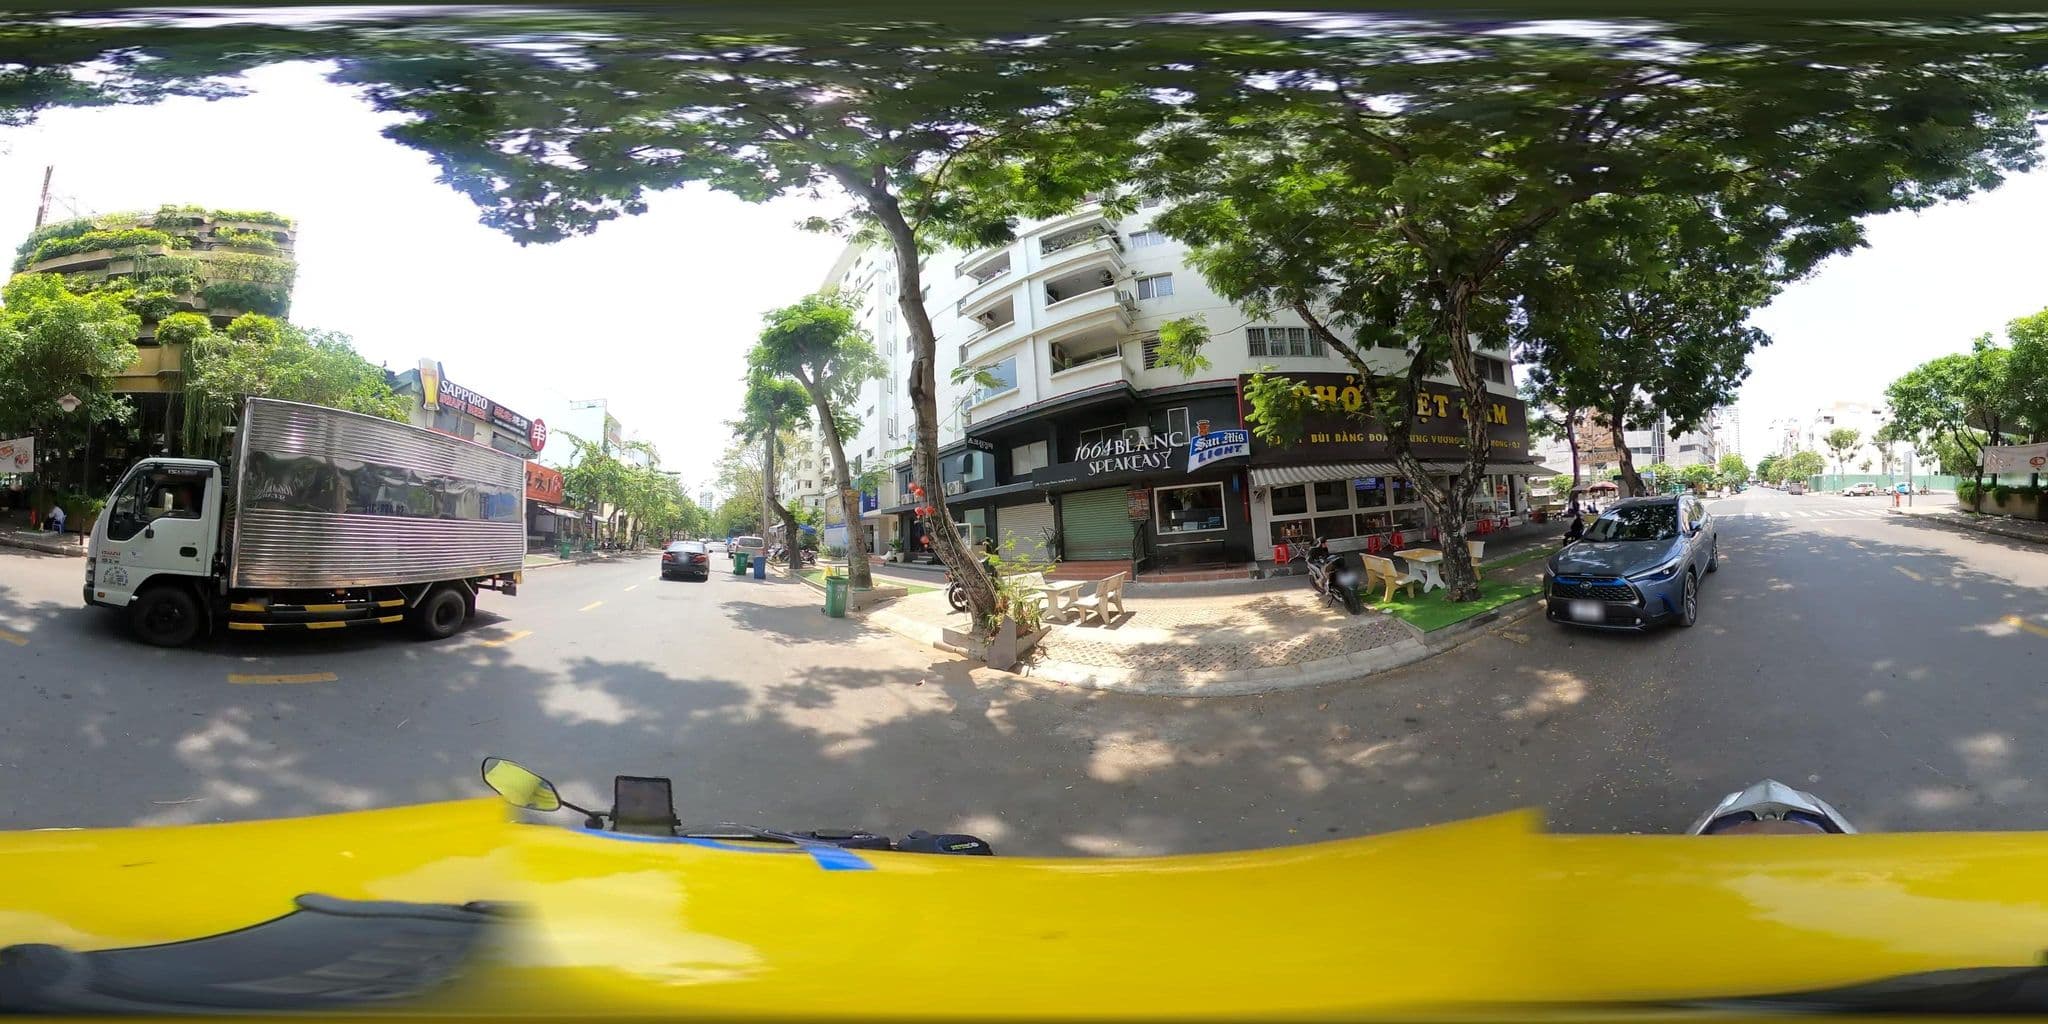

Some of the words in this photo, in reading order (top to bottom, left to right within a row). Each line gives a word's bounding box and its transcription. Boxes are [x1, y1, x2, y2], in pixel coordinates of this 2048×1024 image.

[440, 380, 488, 410] SAPPORO
[1075, 438, 1112, 462] 1664
[1114, 431, 1184, 456] BLANC
[1195, 437, 1220, 451] San
[1222, 431, 1245, 445] Mig
[1198, 444, 1242, 463] LIGHT
[1088, 447, 1173, 476] SPEAKEASY
